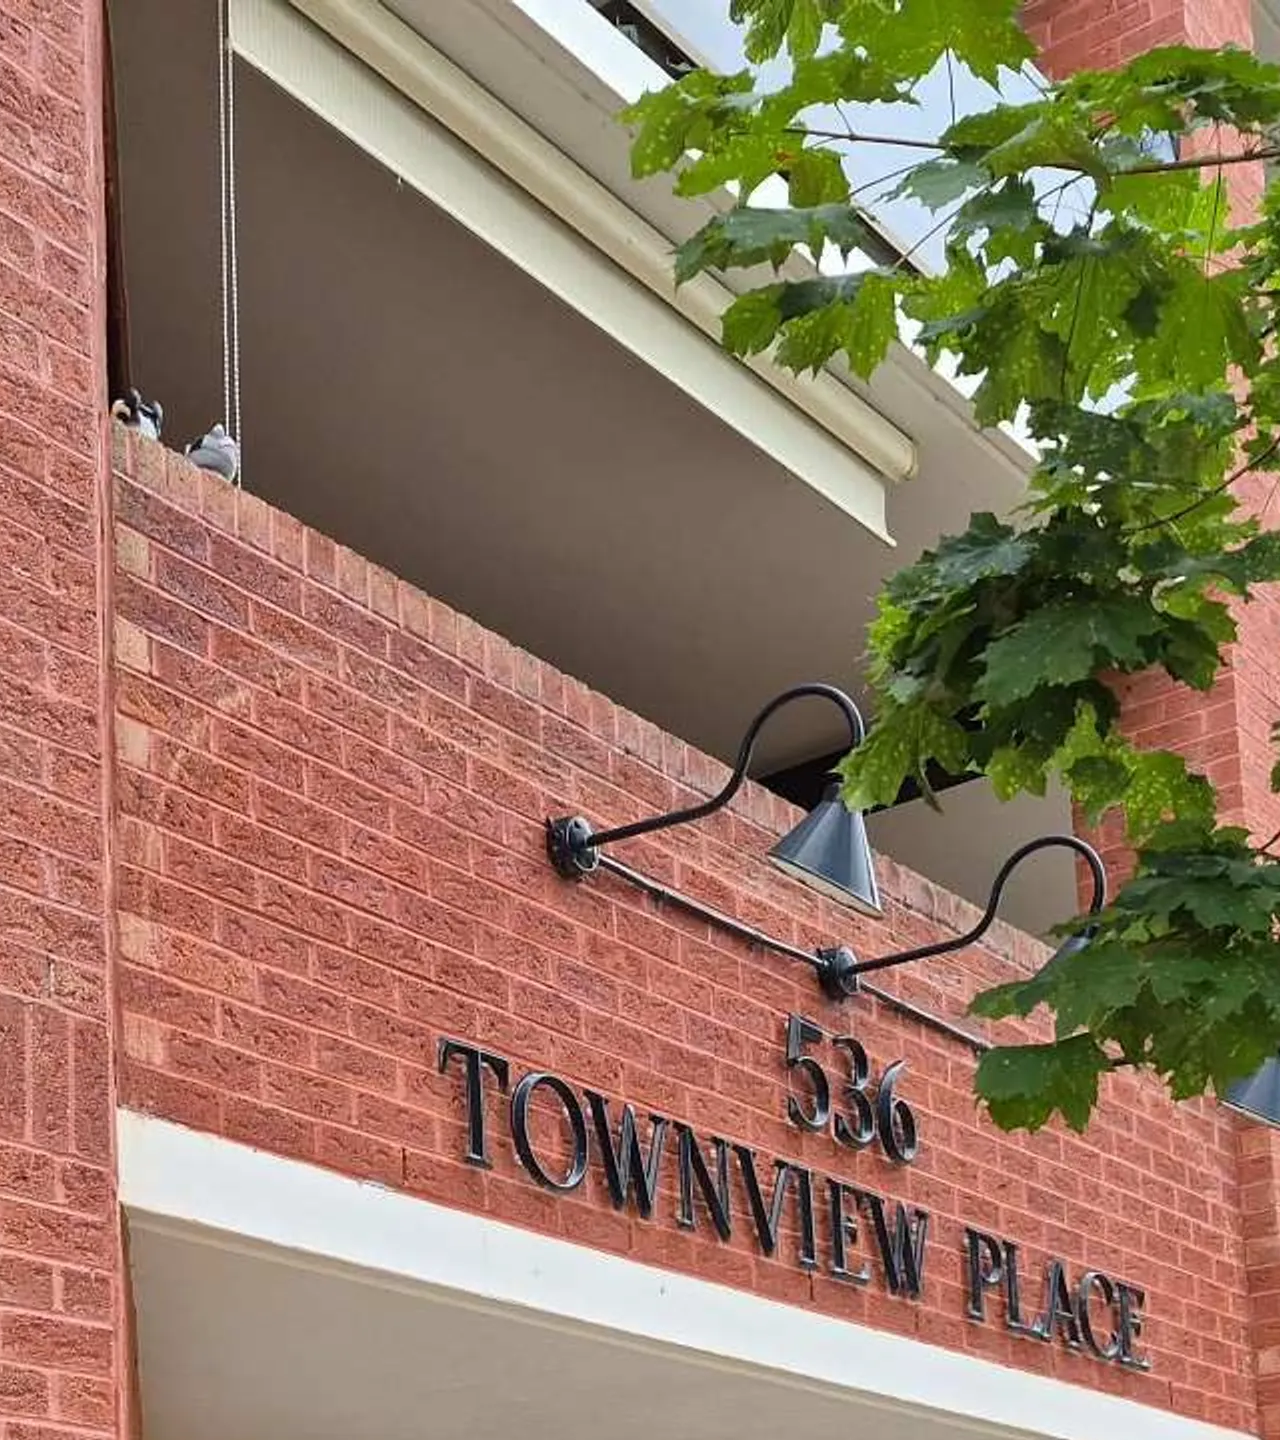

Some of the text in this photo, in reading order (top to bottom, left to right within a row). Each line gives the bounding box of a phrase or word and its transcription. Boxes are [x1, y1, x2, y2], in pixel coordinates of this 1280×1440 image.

[437, 1036, 1150, 1370] TOWNVIEW PLACE
[786, 1012, 918, 1165] 536
